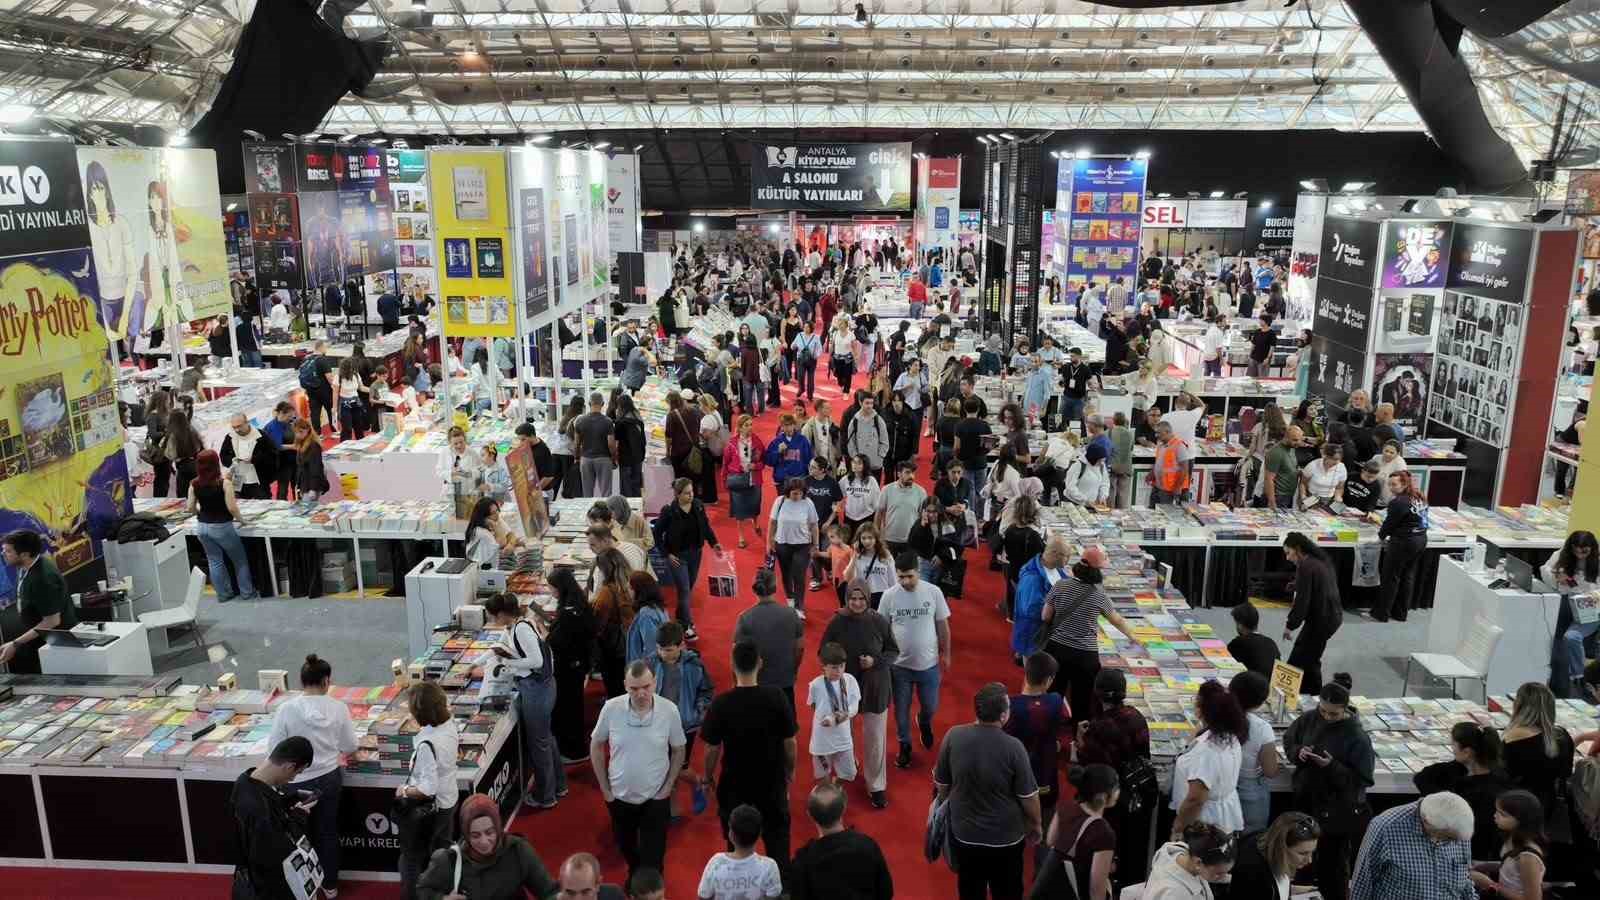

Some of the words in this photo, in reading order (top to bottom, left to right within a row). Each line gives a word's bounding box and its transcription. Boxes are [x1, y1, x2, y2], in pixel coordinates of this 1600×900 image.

[807, 147, 848, 156] ANTALYA
[798, 155, 826, 166] KİTAP
[827, 156, 857, 166] FUARI
[782, 172, 791, 184] A
[794, 172, 838, 184] SALONU
[757, 185, 800, 200] KÜLTÜR
[803, 189, 863, 201] YAYINLARI
[16, 209, 86, 229] YAYINLARI
[1143, 206, 1184, 223] SEL
[25, 286, 90, 356] Potter
[896, 608, 911, 617] NEW
[1279, 673, 1292, 686] 25
[371, 818, 383, 830] Y
[339, 837, 366, 848] YAPI
